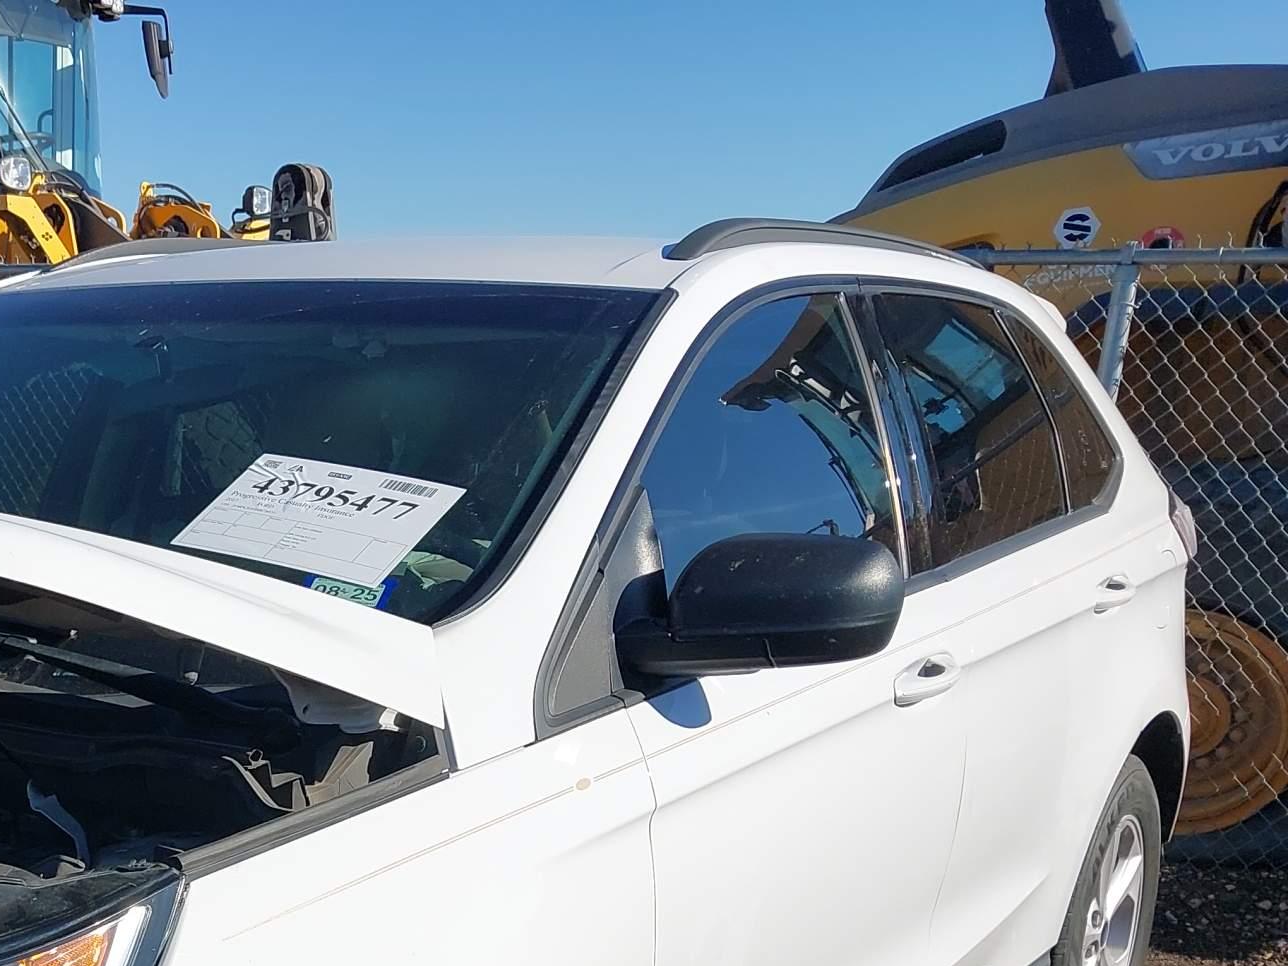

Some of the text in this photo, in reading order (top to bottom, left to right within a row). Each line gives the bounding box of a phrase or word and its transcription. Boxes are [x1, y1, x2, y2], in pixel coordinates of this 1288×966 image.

[1024, 264, 1118, 287] EQUIPMEN
[252, 476, 419, 520] 43795477
[314, 504, 355, 518] Insurance
